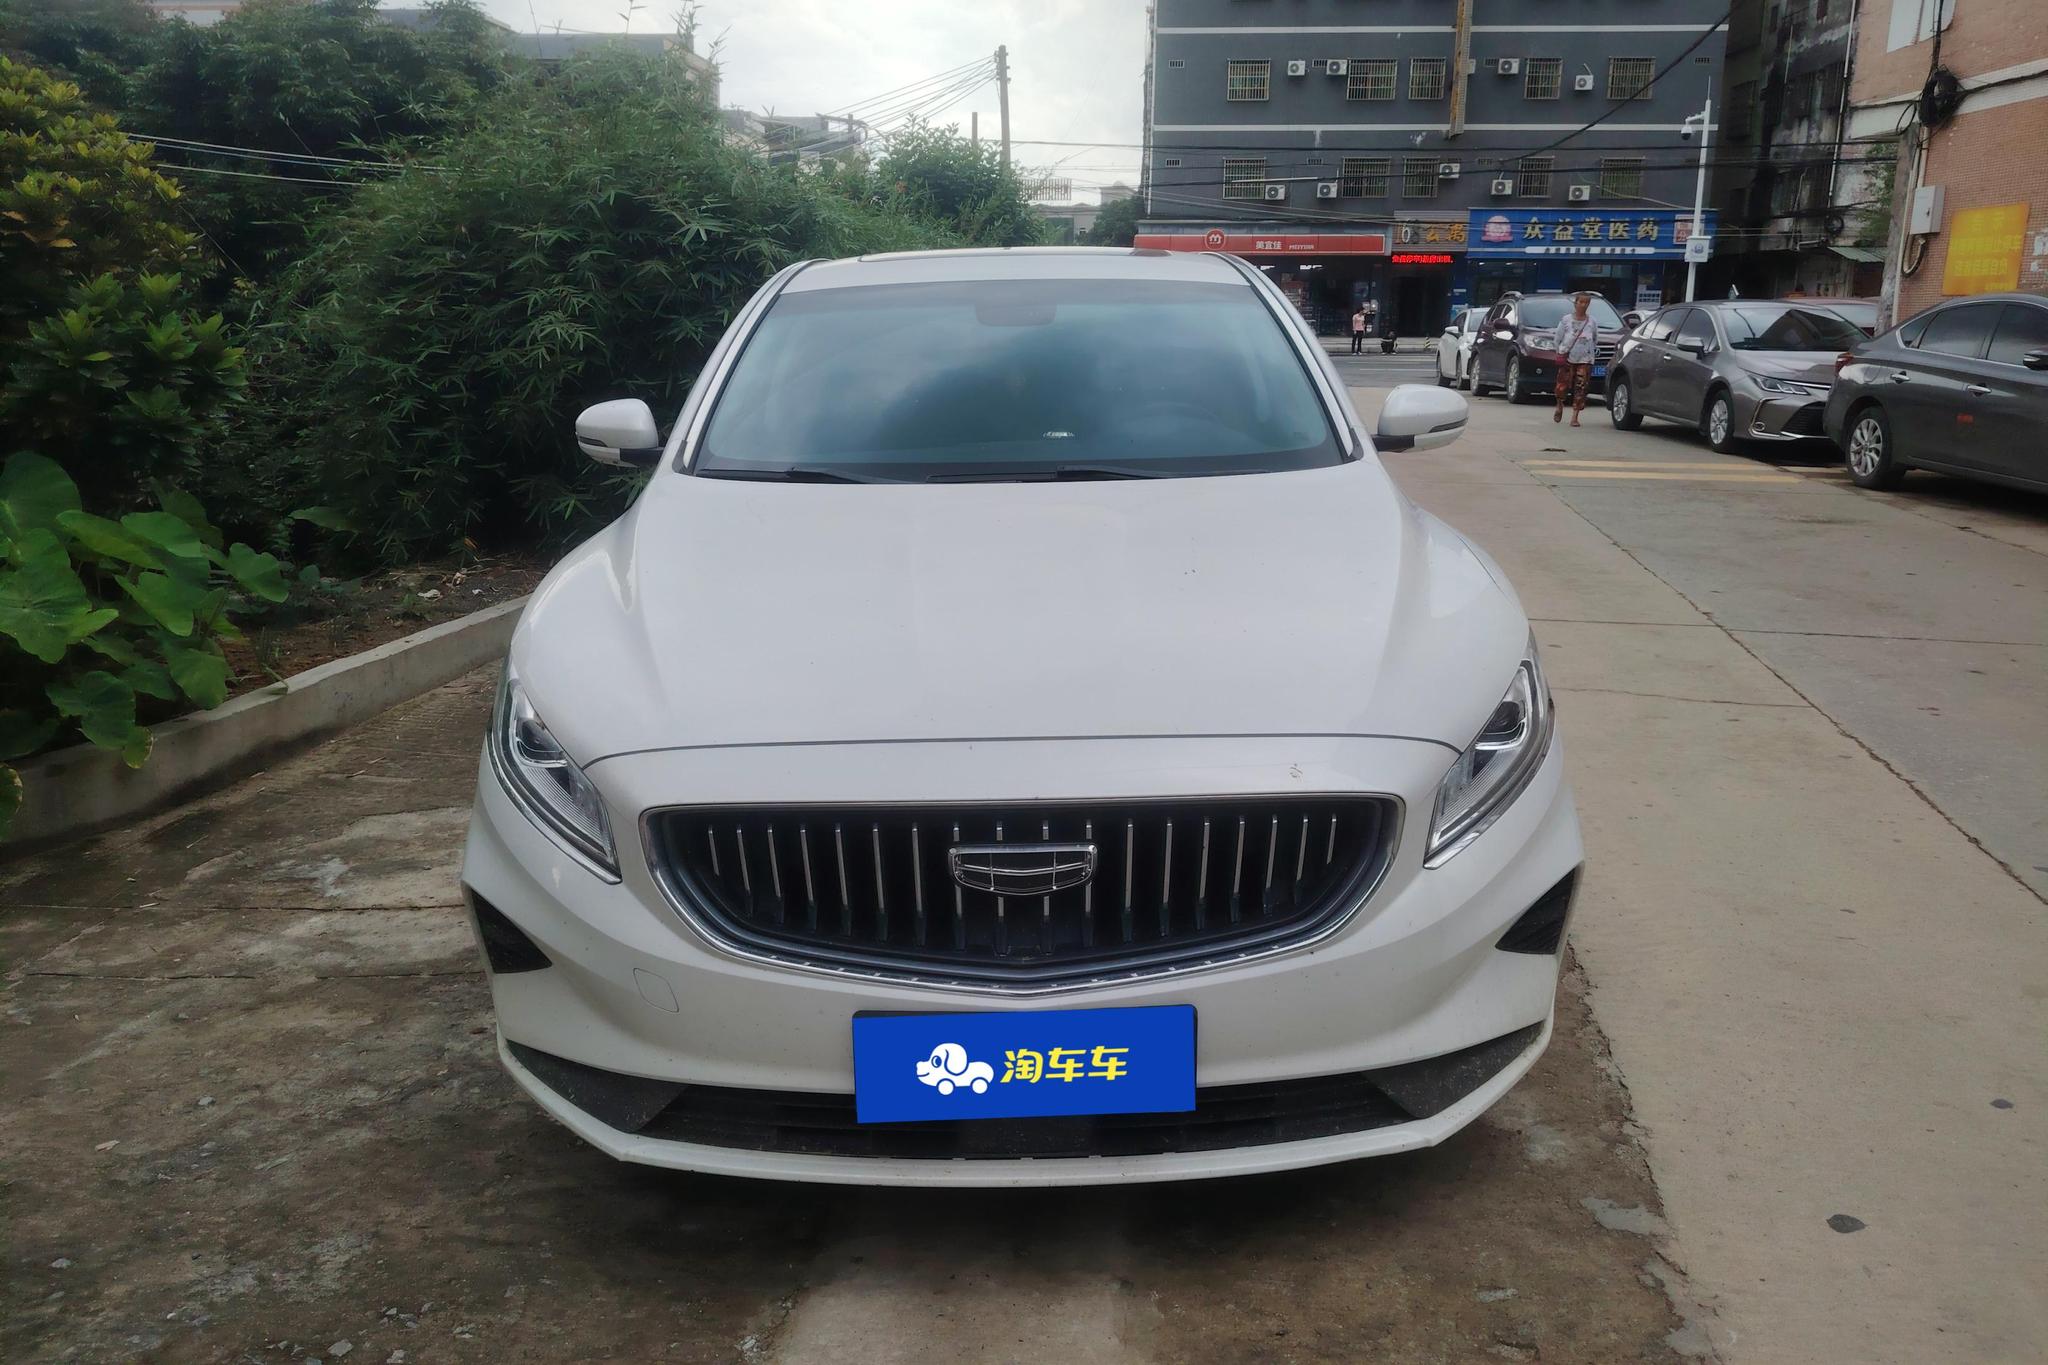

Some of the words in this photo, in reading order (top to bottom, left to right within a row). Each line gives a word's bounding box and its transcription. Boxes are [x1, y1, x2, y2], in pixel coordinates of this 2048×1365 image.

[1522, 216, 1659, 241] 众益堂医药
